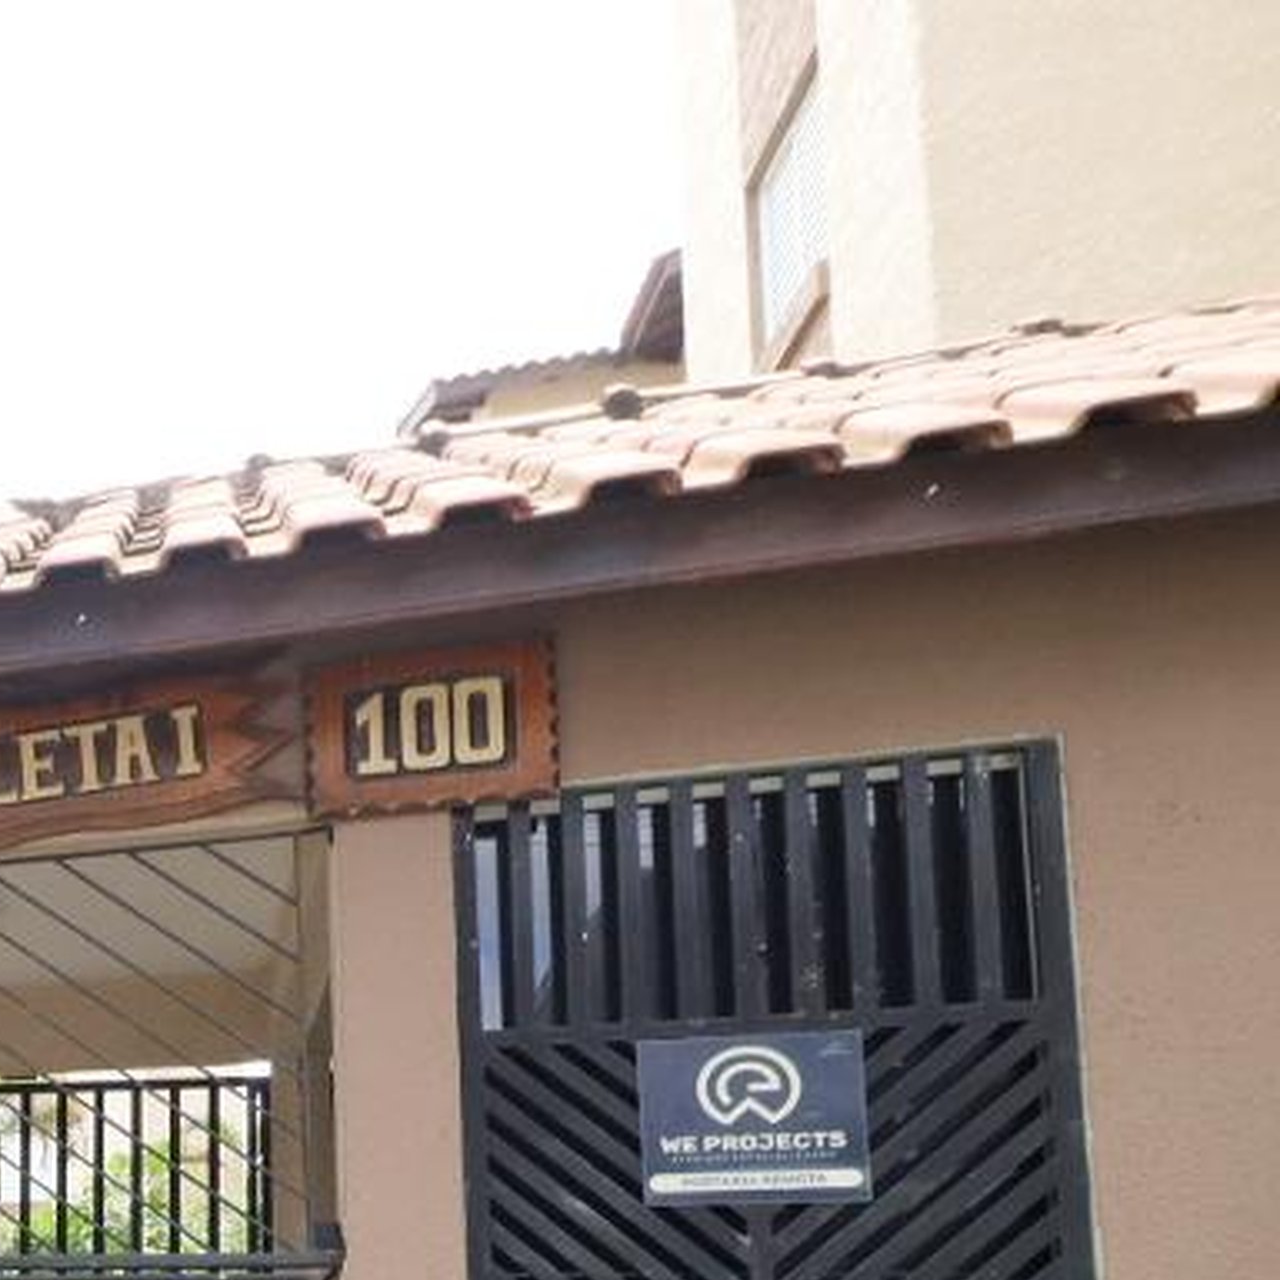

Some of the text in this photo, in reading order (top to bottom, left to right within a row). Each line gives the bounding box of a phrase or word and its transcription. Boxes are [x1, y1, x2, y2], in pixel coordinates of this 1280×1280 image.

[171, 704, 202, 776] I
[355, 676, 505, 775] 100
[660, 1129, 848, 1154] WE PROJECTS
